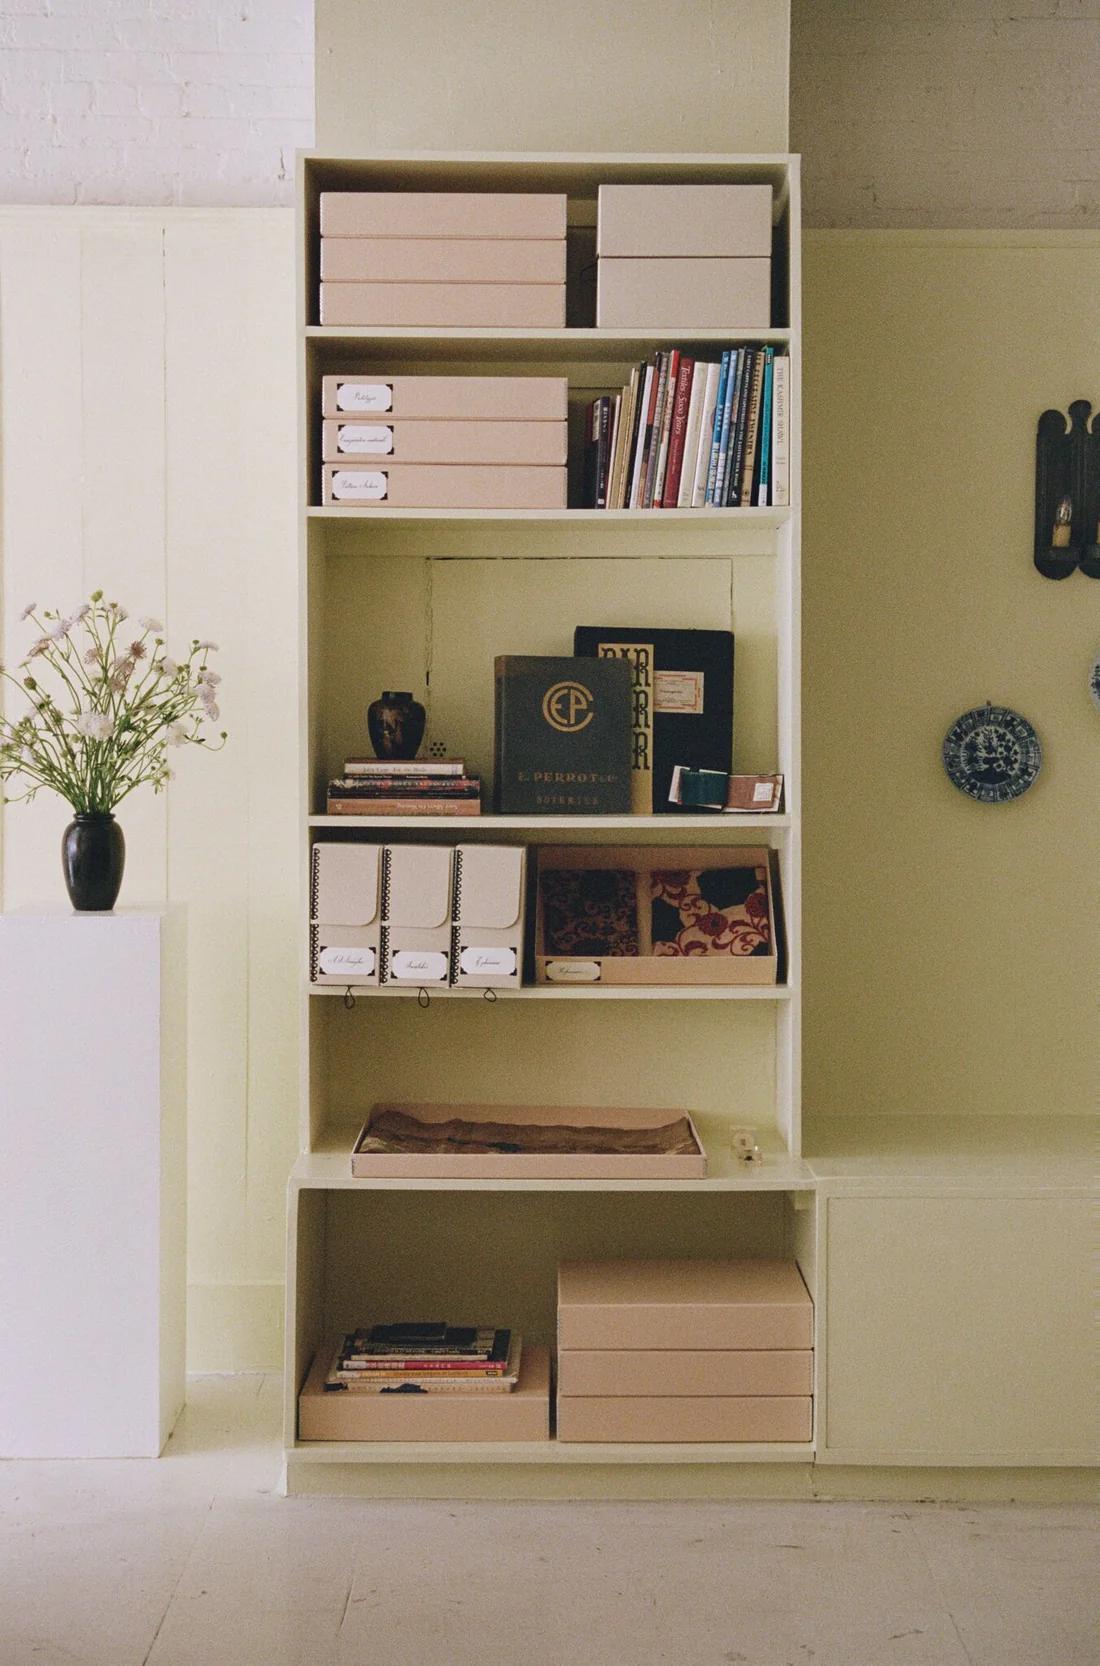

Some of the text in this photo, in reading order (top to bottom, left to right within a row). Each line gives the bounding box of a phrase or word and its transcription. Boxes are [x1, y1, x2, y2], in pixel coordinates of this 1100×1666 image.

[776, 367, 785, 382] THE
[776, 384, 786, 417] KASHMIR
[675, 415, 685, 435] Years
[533, 770, 599, 784] PERROT
